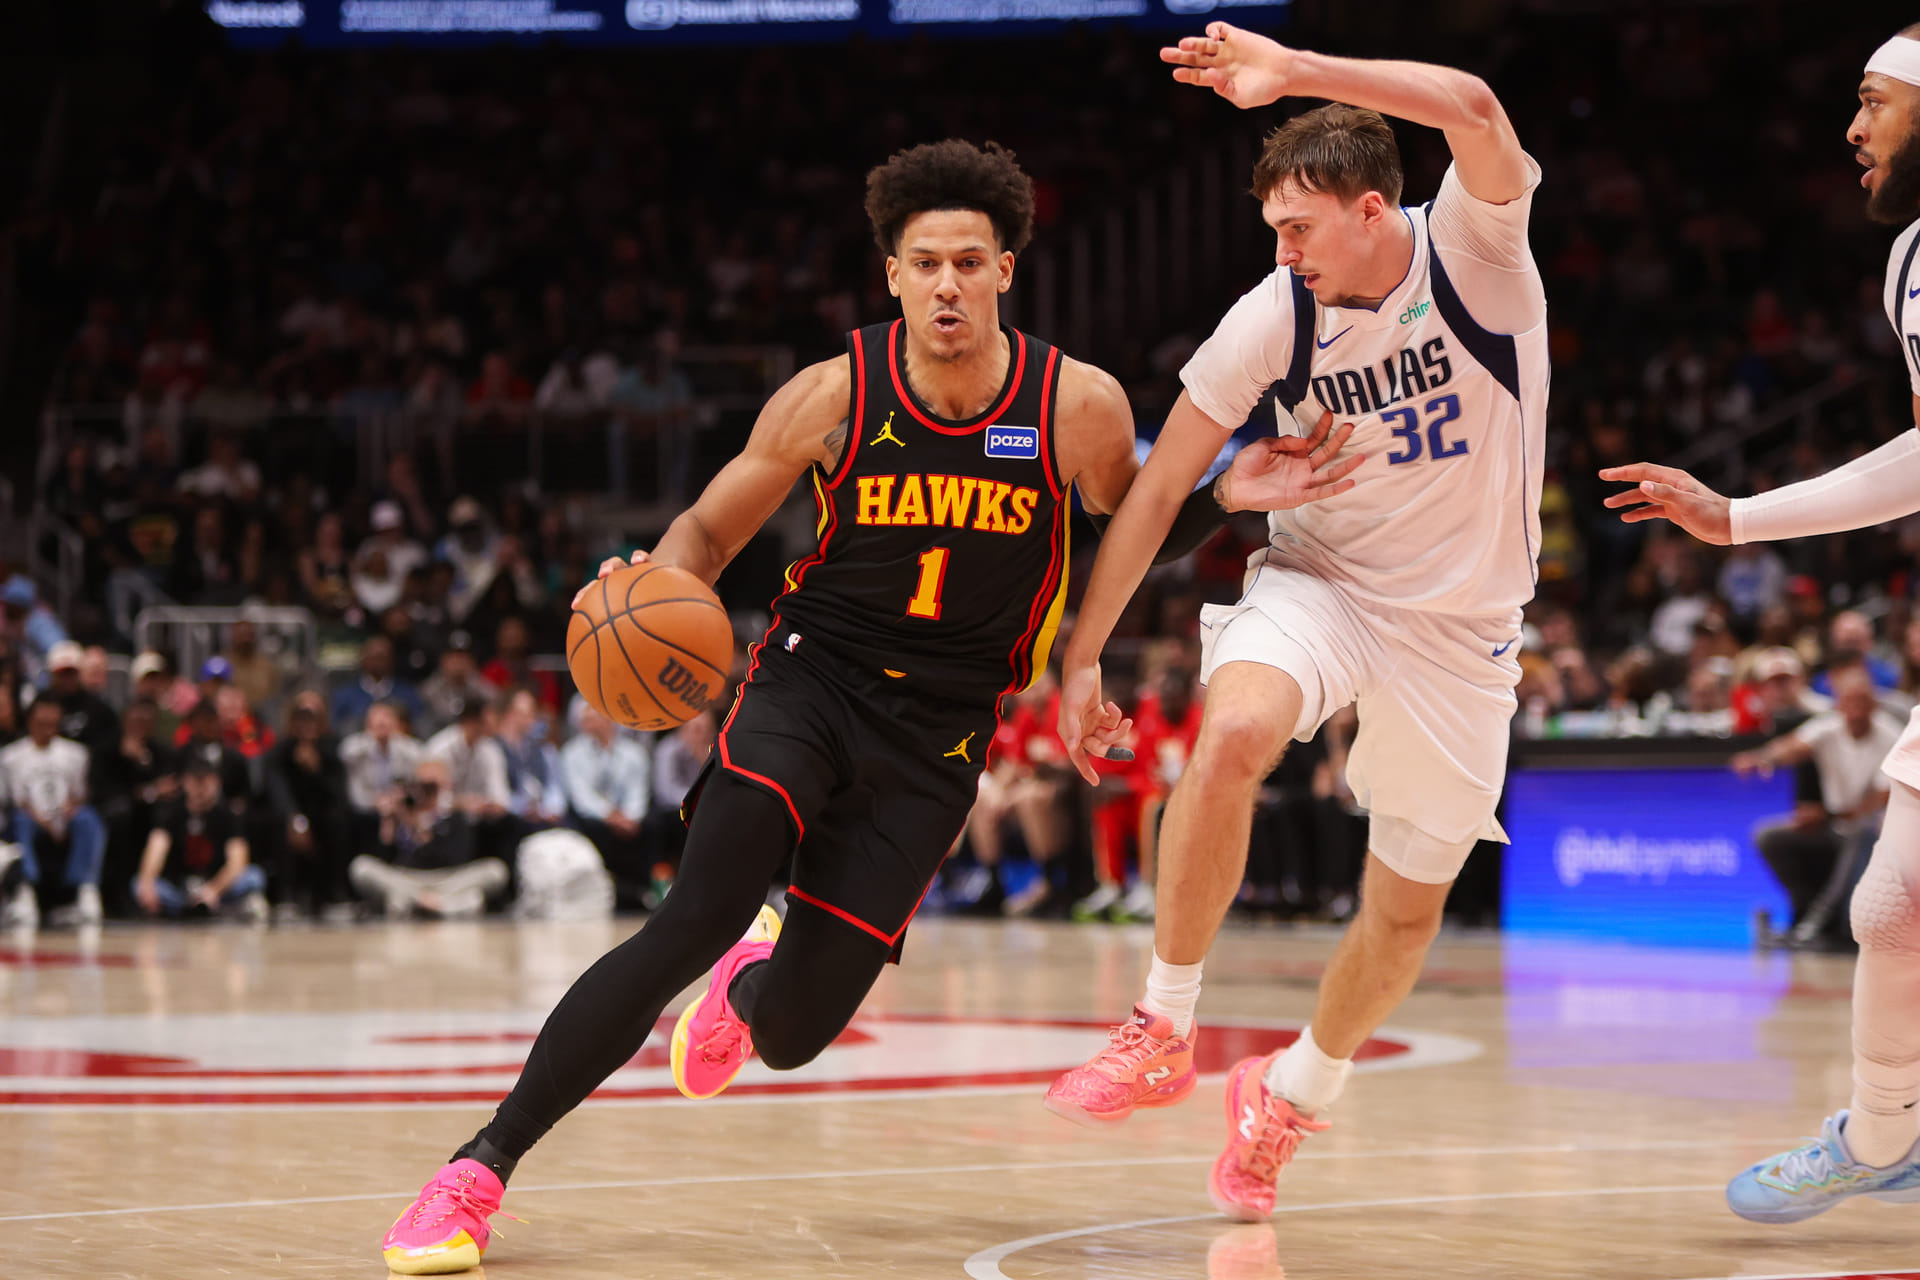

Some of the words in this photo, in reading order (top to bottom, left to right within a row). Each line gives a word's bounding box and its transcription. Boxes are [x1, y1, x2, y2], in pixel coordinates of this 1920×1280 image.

[1399, 301, 1431, 325] chim
[1311, 336, 1452, 416] DALLAS
[989, 433, 1034, 449] paze
[1380, 393, 1469, 466] 32
[856, 473, 1040, 535] HAWKS
[907, 546, 950, 620] 1
[658, 655, 711, 713] Wils
